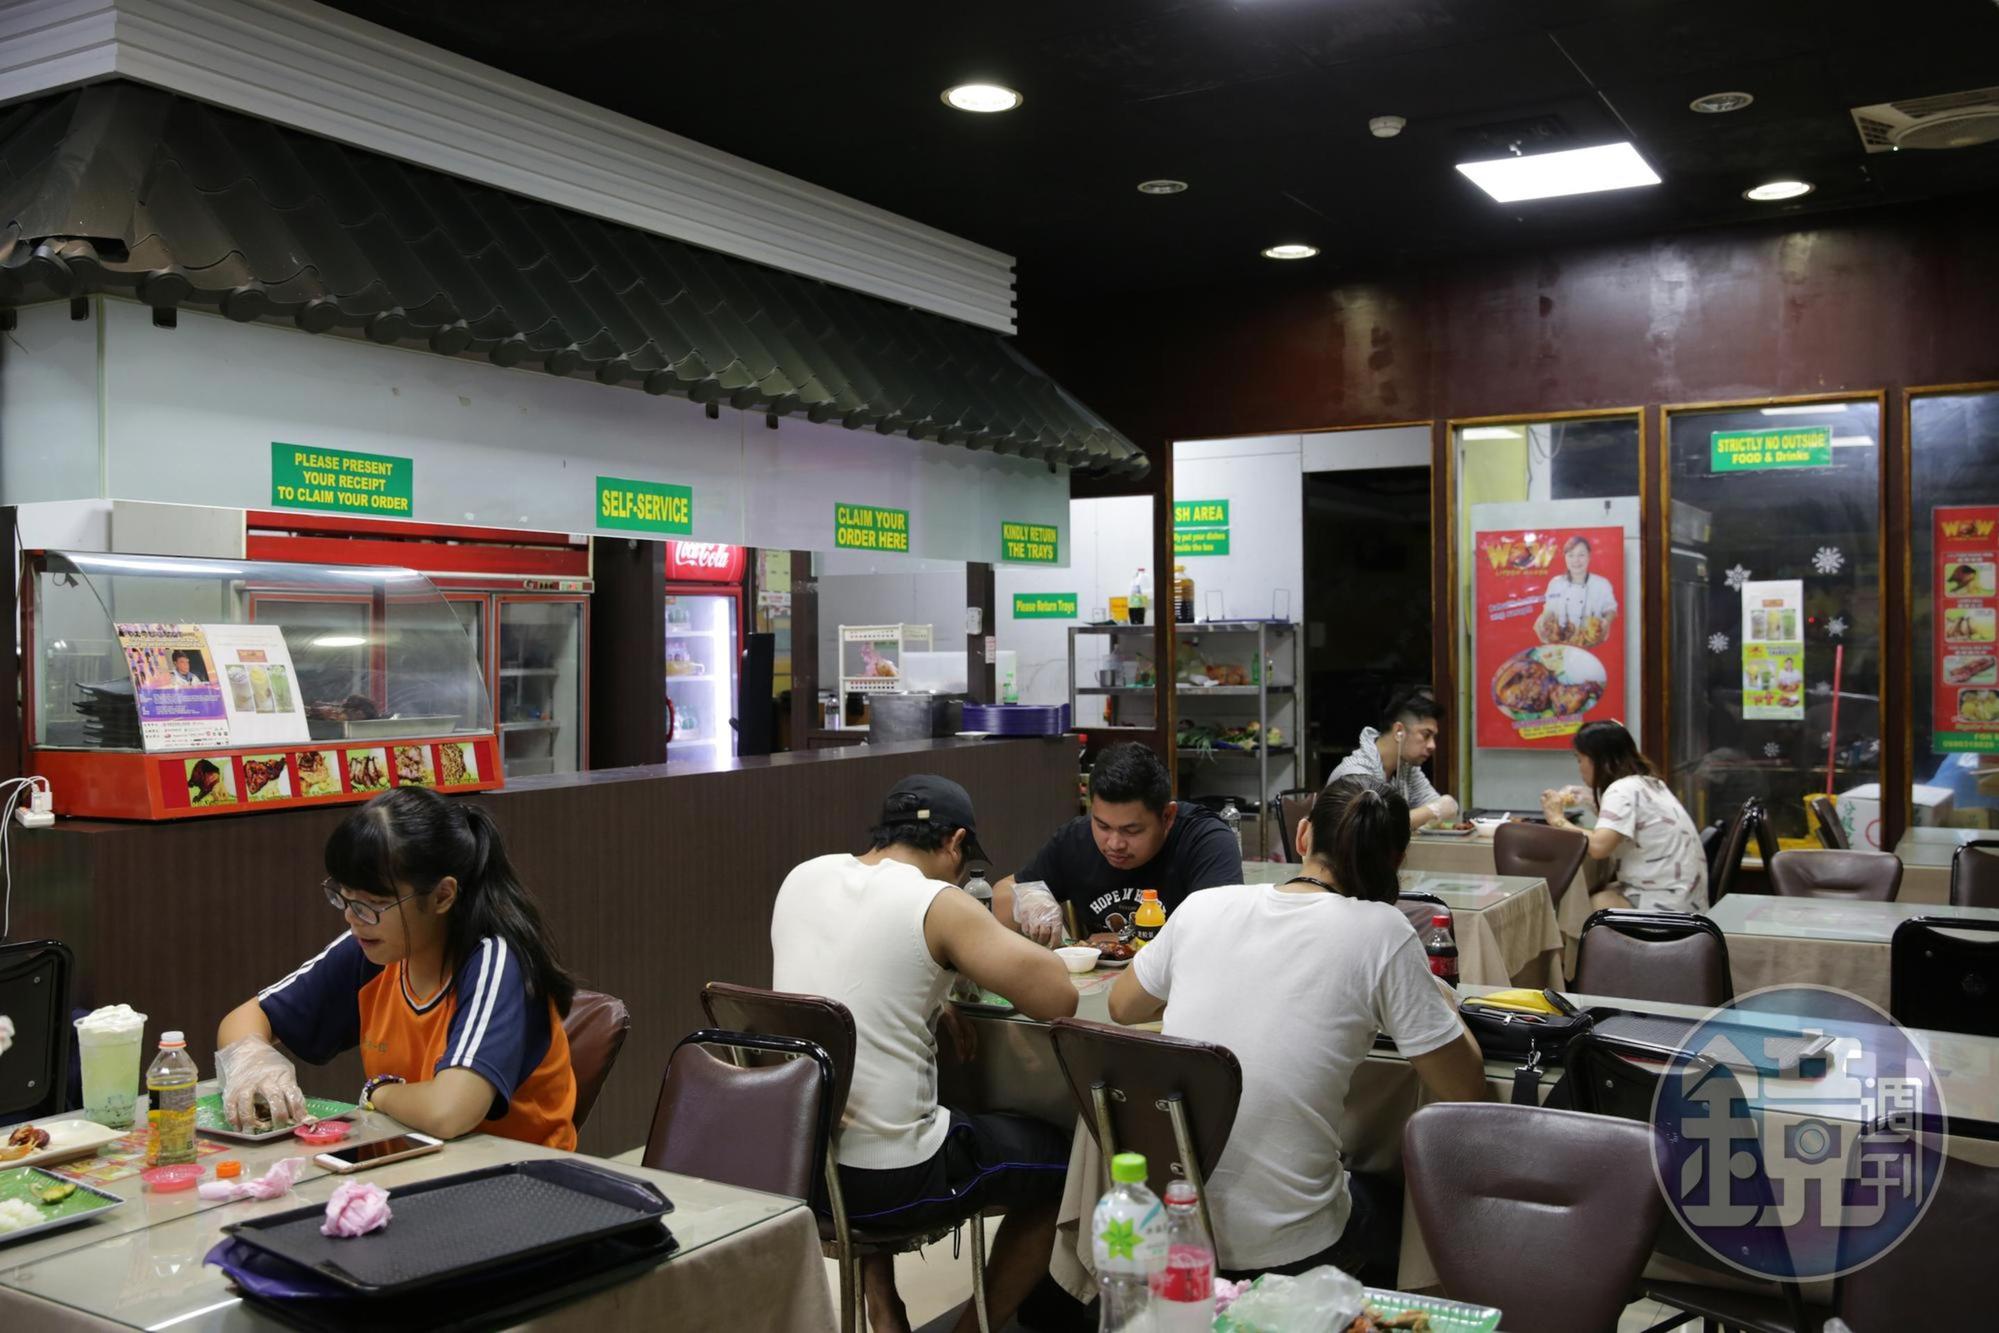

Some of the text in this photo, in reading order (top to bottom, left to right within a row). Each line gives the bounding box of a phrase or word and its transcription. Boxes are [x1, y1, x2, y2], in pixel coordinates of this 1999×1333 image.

[1718, 433, 1825, 453] STRICTLY NO OUTSIDE
[295, 452, 393, 476] PLEASE PRESENT
[1732, 450, 1810, 464] FOOD & Drinks
[303, 471, 386, 492] YOUR RECEIPT
[277, 486, 408, 511] TO CLAIM YOUR ORDER
[601, 490, 689, 524] SELF-SERVICE
[838, 507, 905, 531] CLAIM YOUR
[1193, 506, 1224, 521] AREA
[838, 529, 908, 550] ORDER HERE
[1003, 524, 1057, 543] KINDLY RETURN
[1007, 542, 1054, 560] THE TRAYS
[1016, 600, 1076, 614] Please Return Trays
[1089, 890, 1121, 915] HOPE
